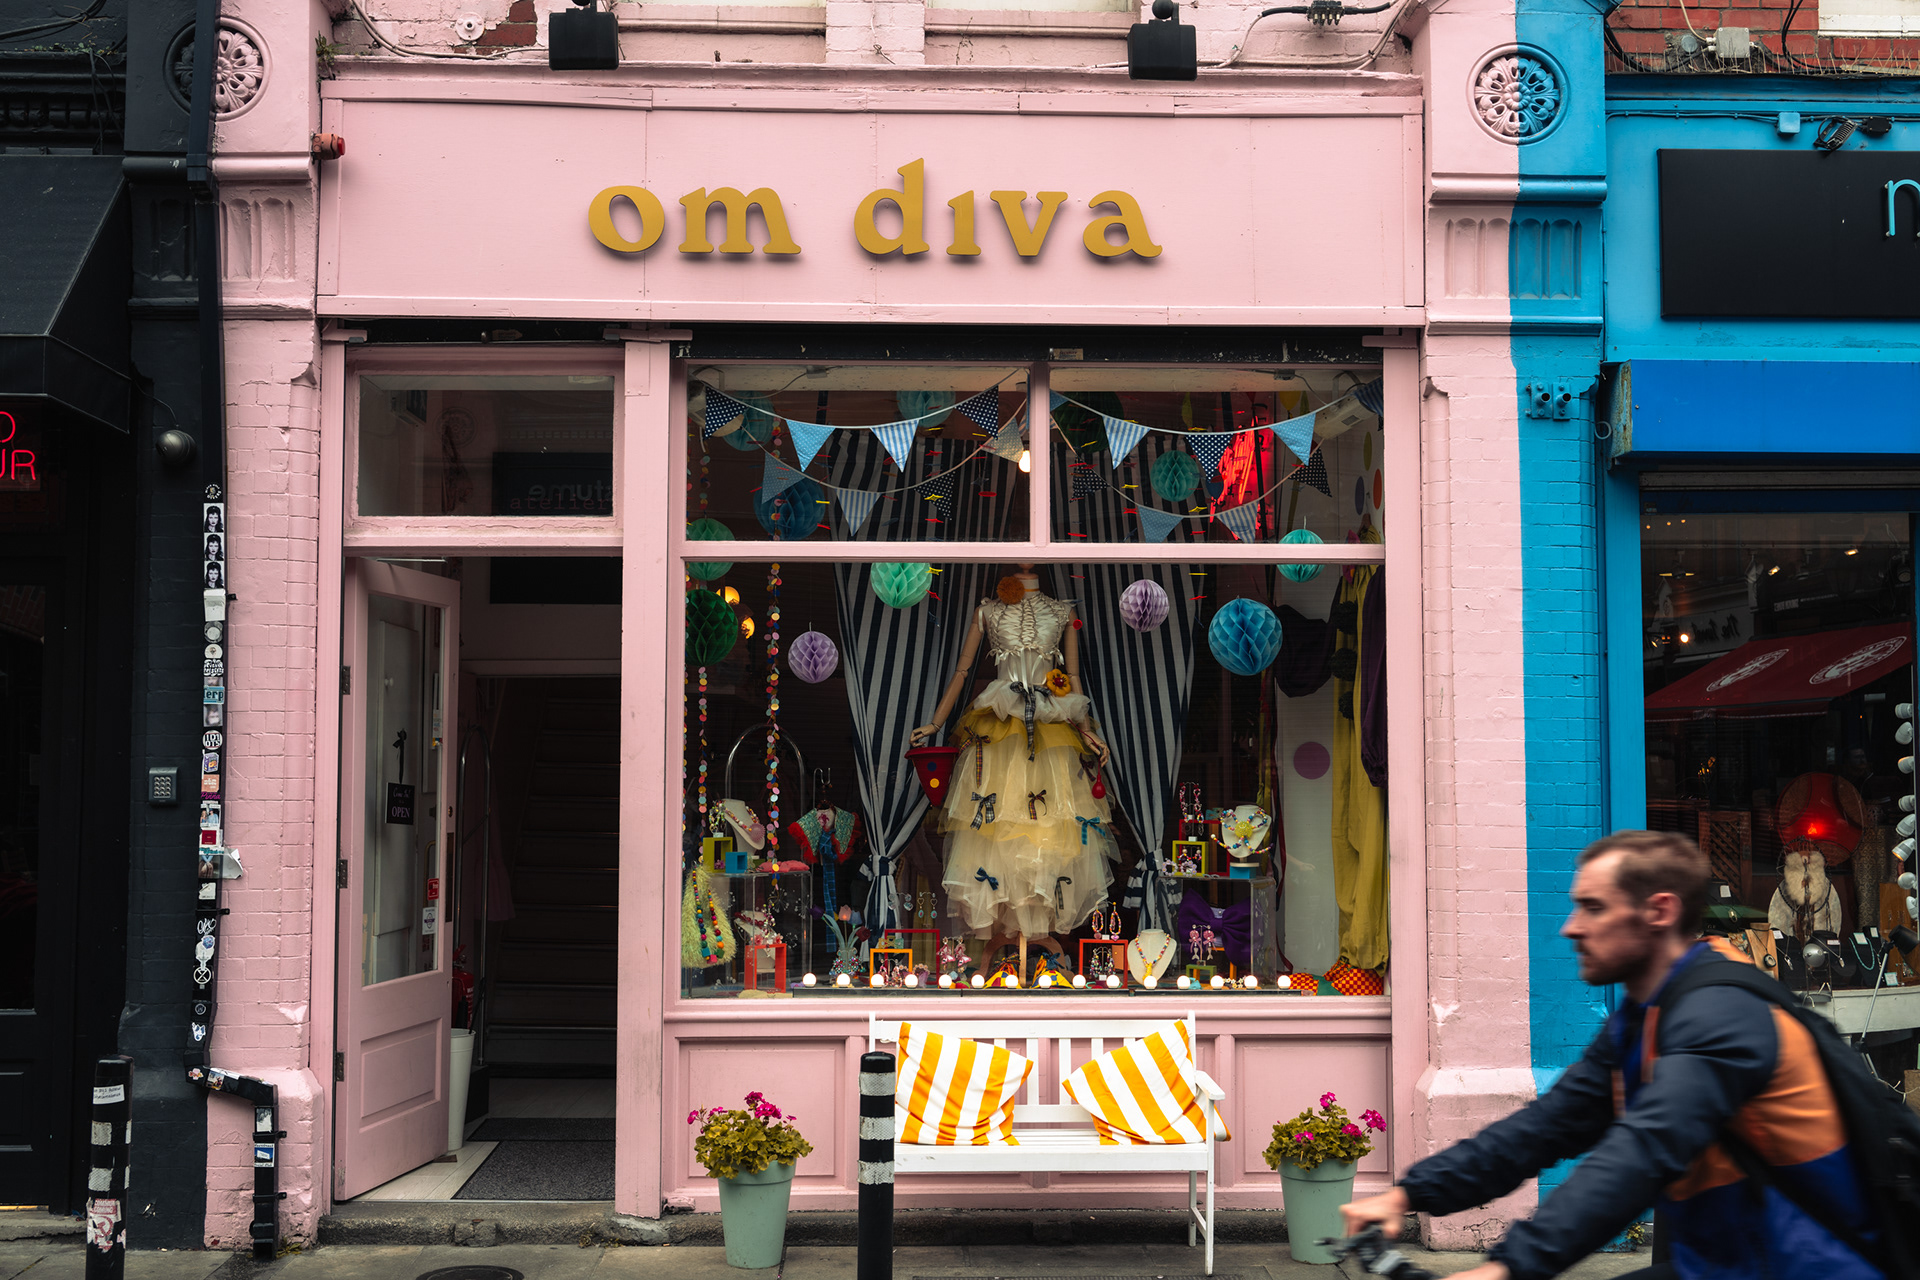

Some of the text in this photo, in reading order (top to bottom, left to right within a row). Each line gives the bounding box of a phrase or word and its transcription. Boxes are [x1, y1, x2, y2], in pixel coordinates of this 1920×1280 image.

[587, 157, 1164, 258] om diva
[510, 493, 609, 510] atelier
[391, 806, 411, 818] OPEN
